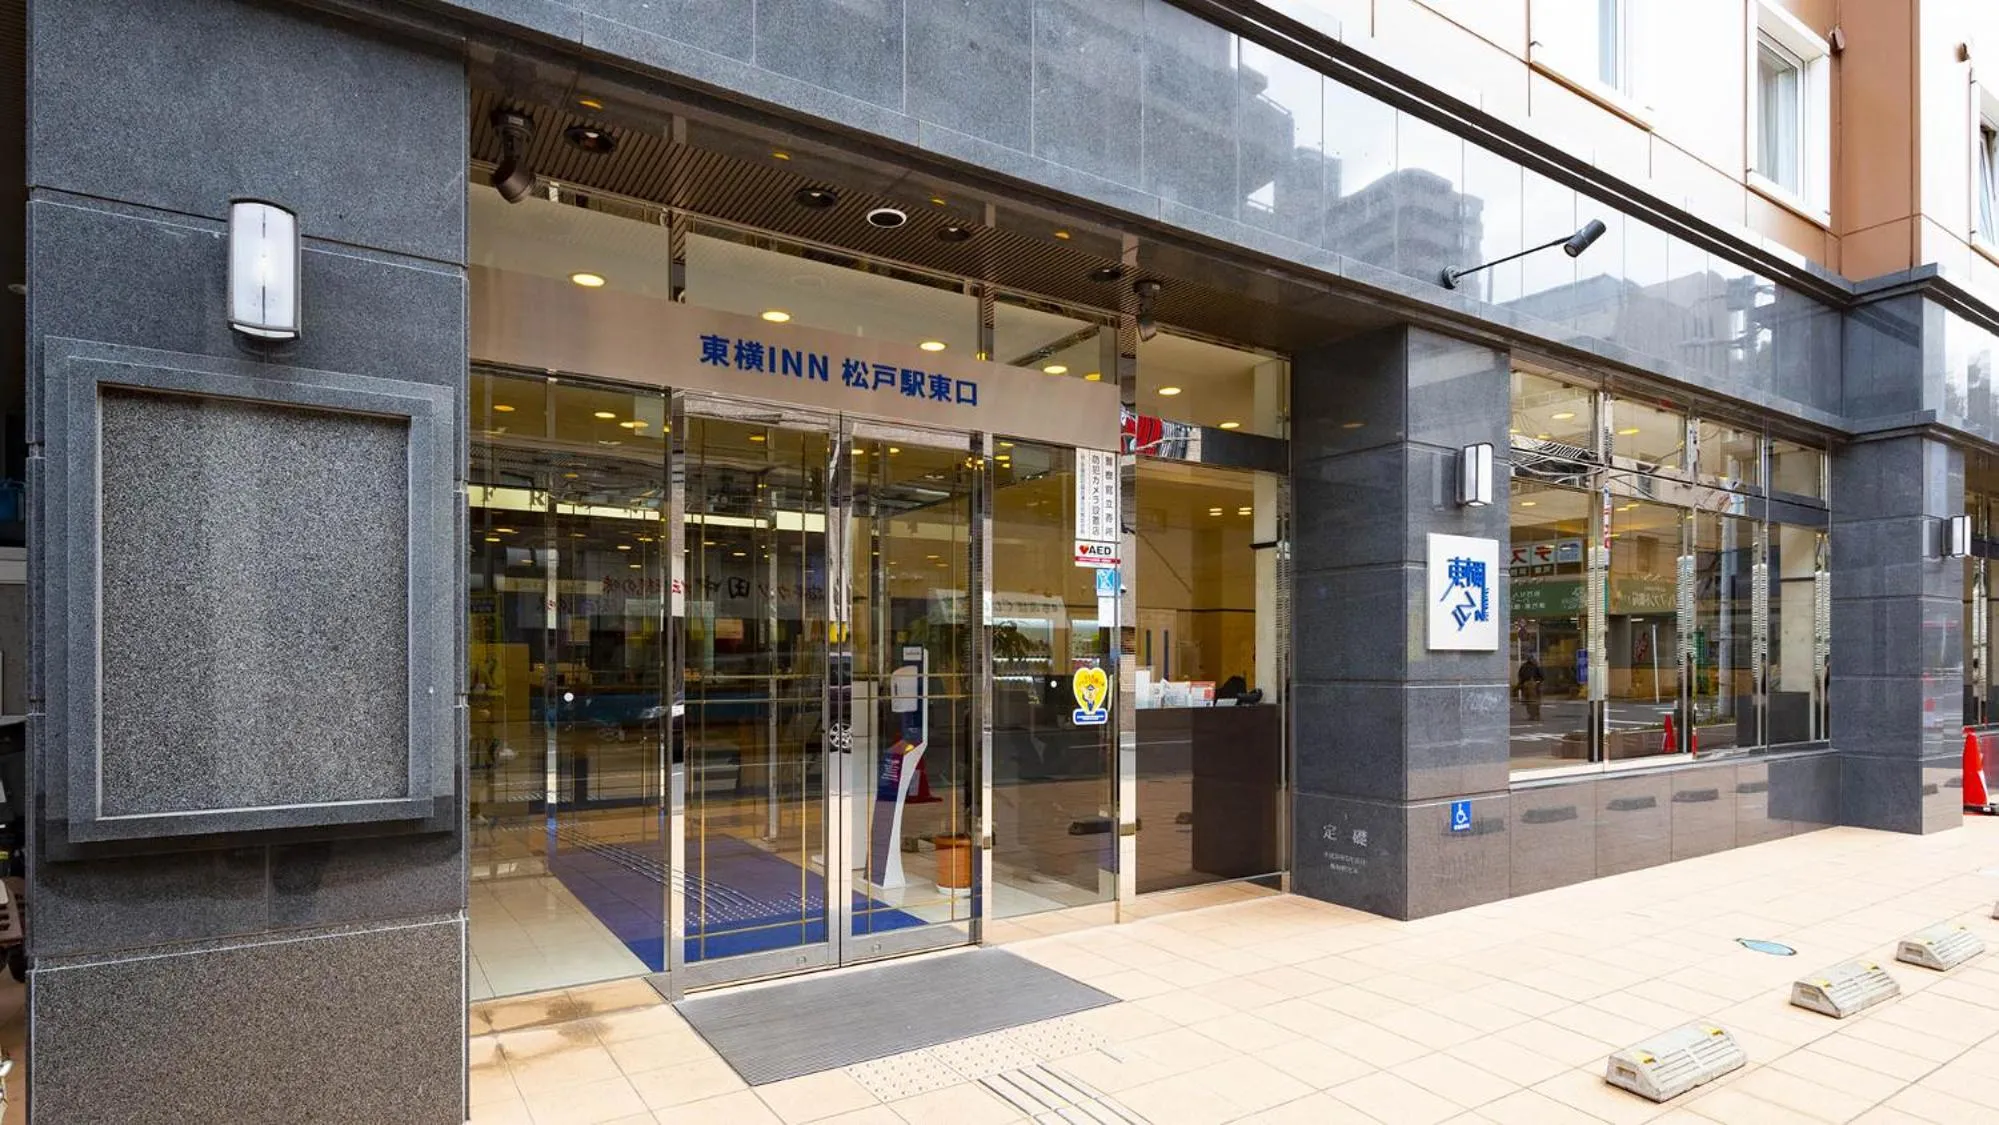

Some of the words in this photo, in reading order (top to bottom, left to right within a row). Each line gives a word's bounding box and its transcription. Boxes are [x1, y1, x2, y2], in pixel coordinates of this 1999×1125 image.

[700, 334, 829, 382] 東横INN
[841, 358, 978, 406] 松戸駅東口
[1088, 545, 1112, 556] AED
